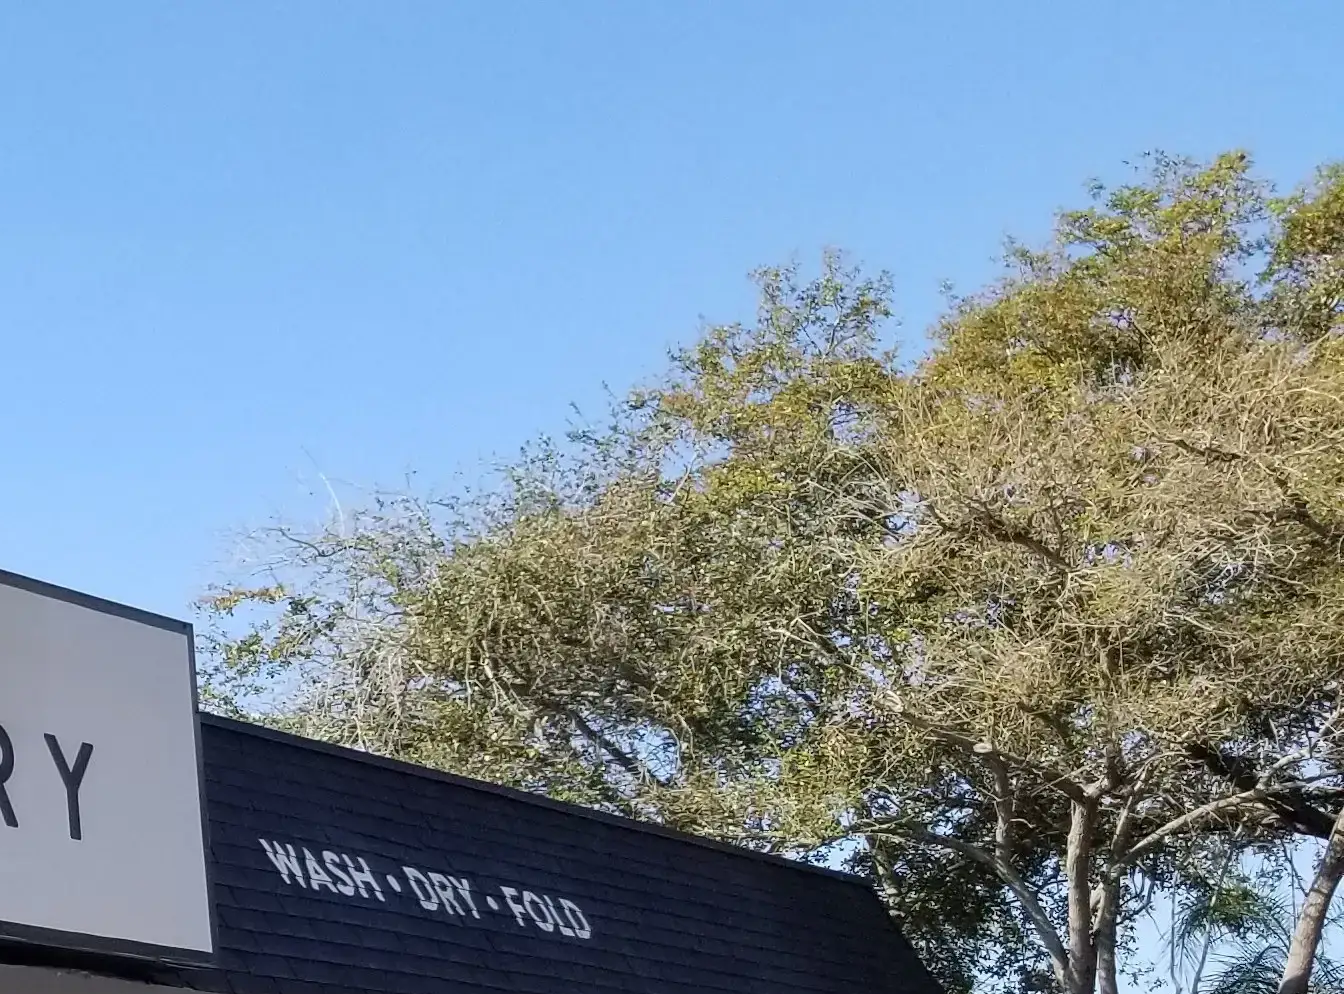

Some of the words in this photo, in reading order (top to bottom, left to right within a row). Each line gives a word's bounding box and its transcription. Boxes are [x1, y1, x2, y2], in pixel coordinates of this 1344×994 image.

[258, 838, 386, 902] WASH
[402, 866, 481, 920] DRY
[499, 885, 593, 940] FOLD
